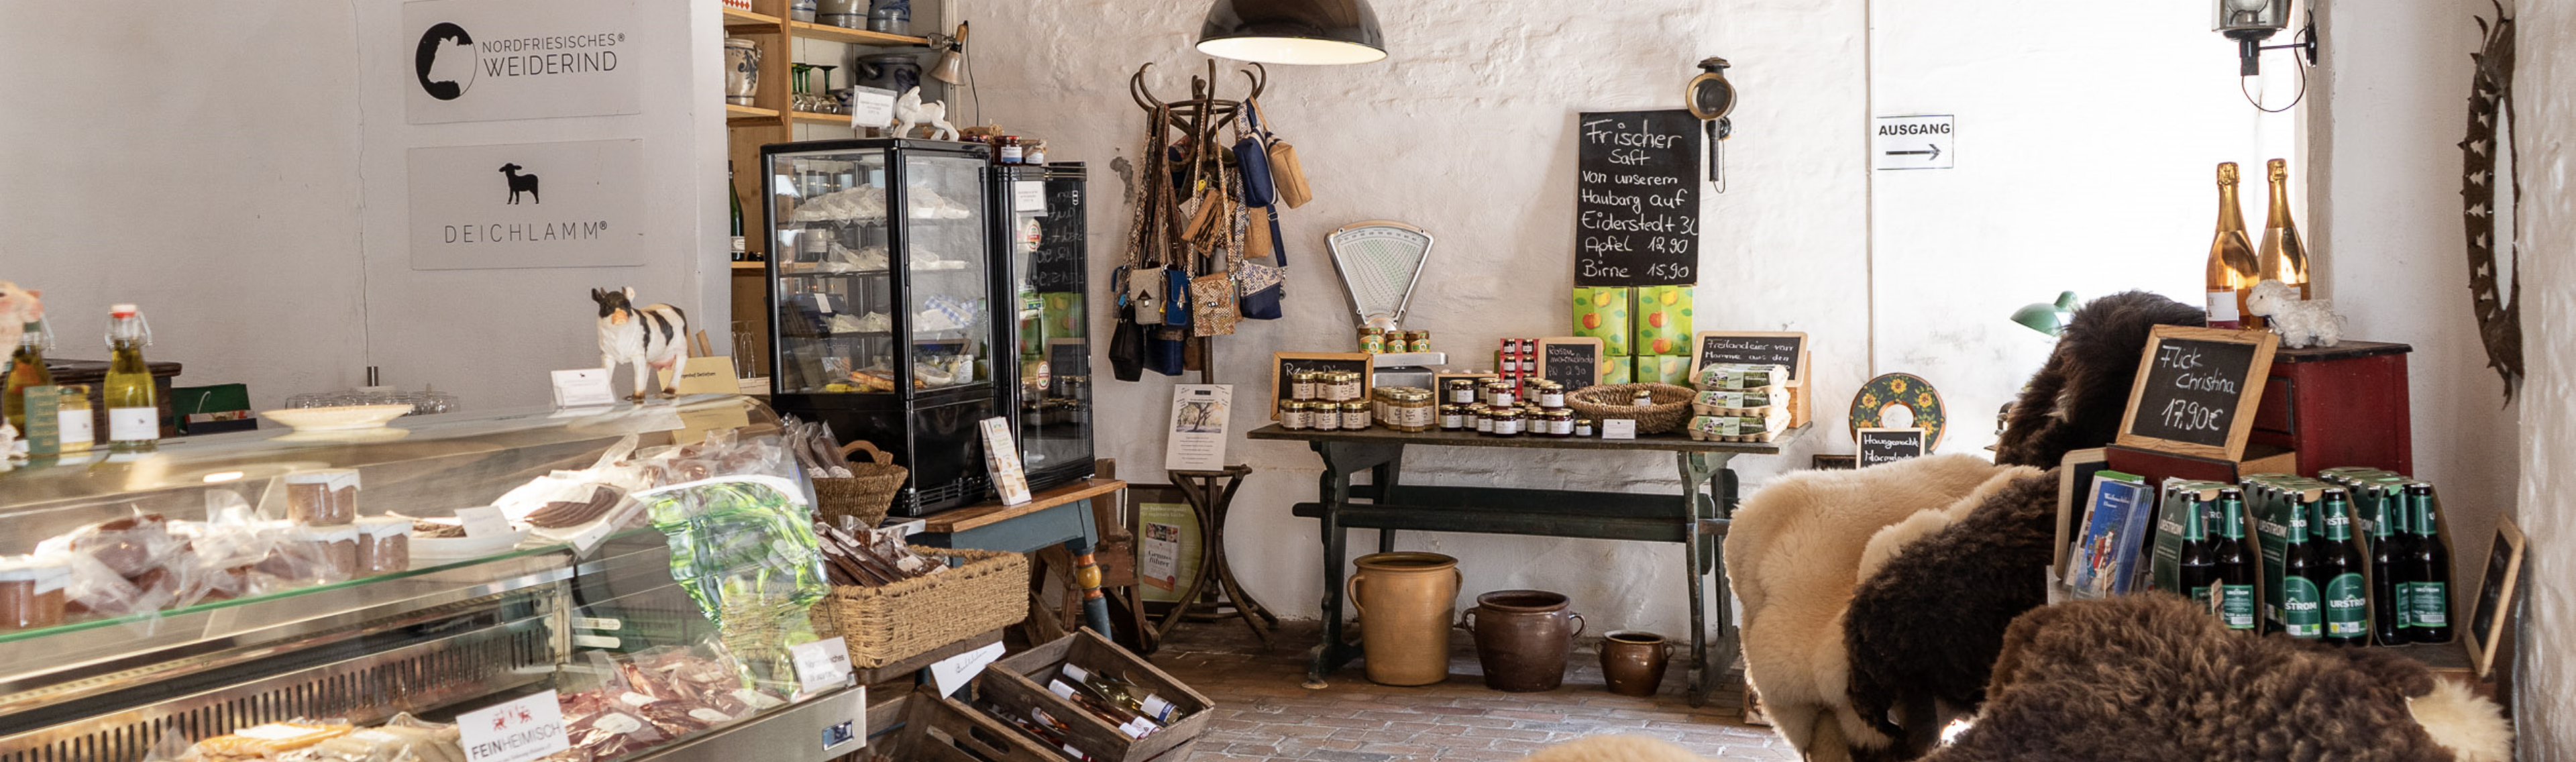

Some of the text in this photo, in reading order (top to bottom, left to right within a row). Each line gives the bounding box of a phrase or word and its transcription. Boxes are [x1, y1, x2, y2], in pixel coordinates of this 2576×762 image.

[484, 51, 617, 77] WEIDERIND
[1583, 119, 1682, 149] Frischer
[1879, 123, 1950, 135] AUSGANG
[1608, 148, 1651, 166] Saft
[1615, 174, 1678, 186] unserem
[1582, 188, 1688, 214] Haubarg auf
[1580, 211, 1676, 233] Eiderstedt
[1585, 235, 1688, 258] Apfel 12,90
[1582, 259, 1689, 280] Birne 15,90
[2161, 345, 2203, 370] Flick
[2176, 368, 2236, 394] Christina
[2286, 602, 2317, 610] STROM
[2330, 598, 2366, 608] URSTRO
[471, 721, 562, 760] FEINHEIMISCH
